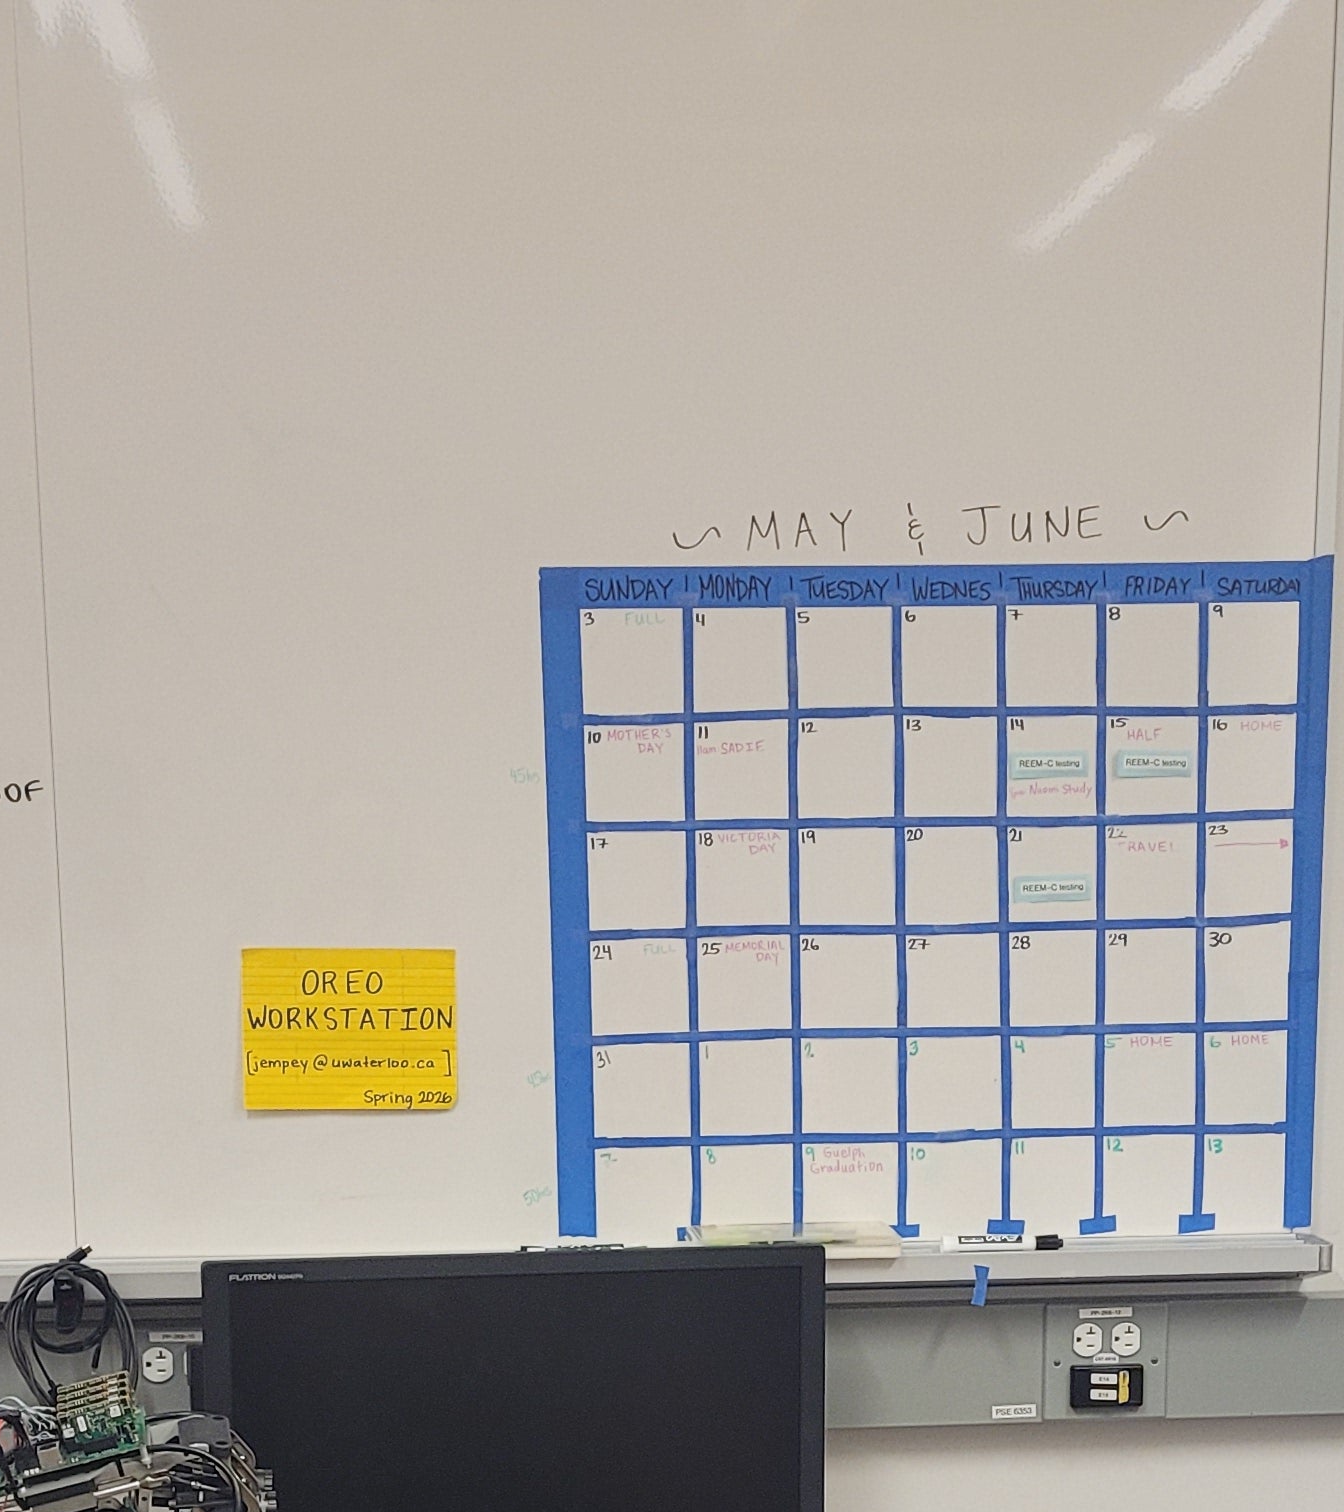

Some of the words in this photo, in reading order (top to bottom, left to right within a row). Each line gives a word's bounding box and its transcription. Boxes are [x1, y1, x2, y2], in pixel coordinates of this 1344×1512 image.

[747, 509, 853, 552] MAY
[962, 504, 1103, 546] JUNE
[584, 576, 675, 603] SUNDAY
[697, 575, 773, 603] MONDAY
[799, 576, 890, 602] TUESDAY
[911, 578, 992, 601] WEDNES
[1009, 574, 1099, 601] THURSDAY
[1124, 575, 1194, 597] FRIDAY
[582, 611, 596, 627] 3
[623, 611, 666, 627] FULL
[797, 610, 811, 624] 5
[904, 609, 917, 623] 6
[1007, 607, 1024, 621] 7
[1108, 606, 1121, 621] 8
[1212, 604, 1224, 619] 9
[695, 612, 706, 627] 4
[801, 721, 818, 735] 12
[905, 718, 922, 732] 13
[1009, 717, 1025, 732] 14
[1110, 716, 1130, 729] 15
[1211, 717, 1228, 731] 16
[1240, 719, 1283, 732] HOME
[586, 731, 602, 745] 10
[606, 727, 672, 742] MOTHER'S
[698, 726, 709, 740] 11
[1127, 727, 1163, 742] HALF
[637, 740, 664, 755] DAY
[1018, 758, 1054, 769] REEM-C
[1054, 758, 1081, 771] testing
[1125, 757, 1161, 768] REEM-C
[1161, 757, 1188, 770] testing
[1061, 780, 1093, 799] Study
[801, 830, 817, 845] 19
[905, 827, 924, 842] 20
[1009, 827, 1023, 843] 21
[1208, 824, 1229, 837] 23
[590, 836, 610, 851] 17
[698, 832, 715, 847] 18
[717, 830, 783, 846] VICTORIA
[748, 842, 779, 856] DAY
[1022, 883, 1058, 894] REEM-C
[1058, 881, 1085, 894] testing
[801, 938, 820, 952] 26
[907, 937, 931, 951] 27
[1011, 935, 1032, 950] 28
[1107, 933, 1129, 948] 29
[1208, 931, 1233, 948] 30
[592, 944, 613, 961] 24
[642, 942, 677, 956] FULL
[701, 942, 723, 956] 25
[724, 940, 785, 954] MEMORIAL
[755, 950, 780, 965] DAY
[301, 969, 384, 996] OREO
[247, 1004, 454, 1031] WORKSTATION
[908, 1040, 919, 1056] 3
[1013, 1039, 1026, 1055] 4
[1104, 1036, 1123, 1050] 5
[1129, 1034, 1174, 1048] HOME
[1209, 1035, 1222, 1050] 6
[1230, 1033, 1270, 1047] HOME
[596, 1050, 612, 1069] 31
[704, 1045, 710, 1060] 1
[363, 1089, 414, 1110] Spring
[417, 1090, 453, 1105] 2026
[1014, 1140, 1025, 1156] 11
[1105, 1137, 1124, 1153] 12
[1207, 1138, 1224, 1153] 13
[705, 1149, 717, 1165] 8
[805, 1146, 816, 1163] 9
[822, 1146, 866, 1163] Guelph
[909, 1147, 927, 1161] 10
[809, 1160, 885, 1175] Graduation
